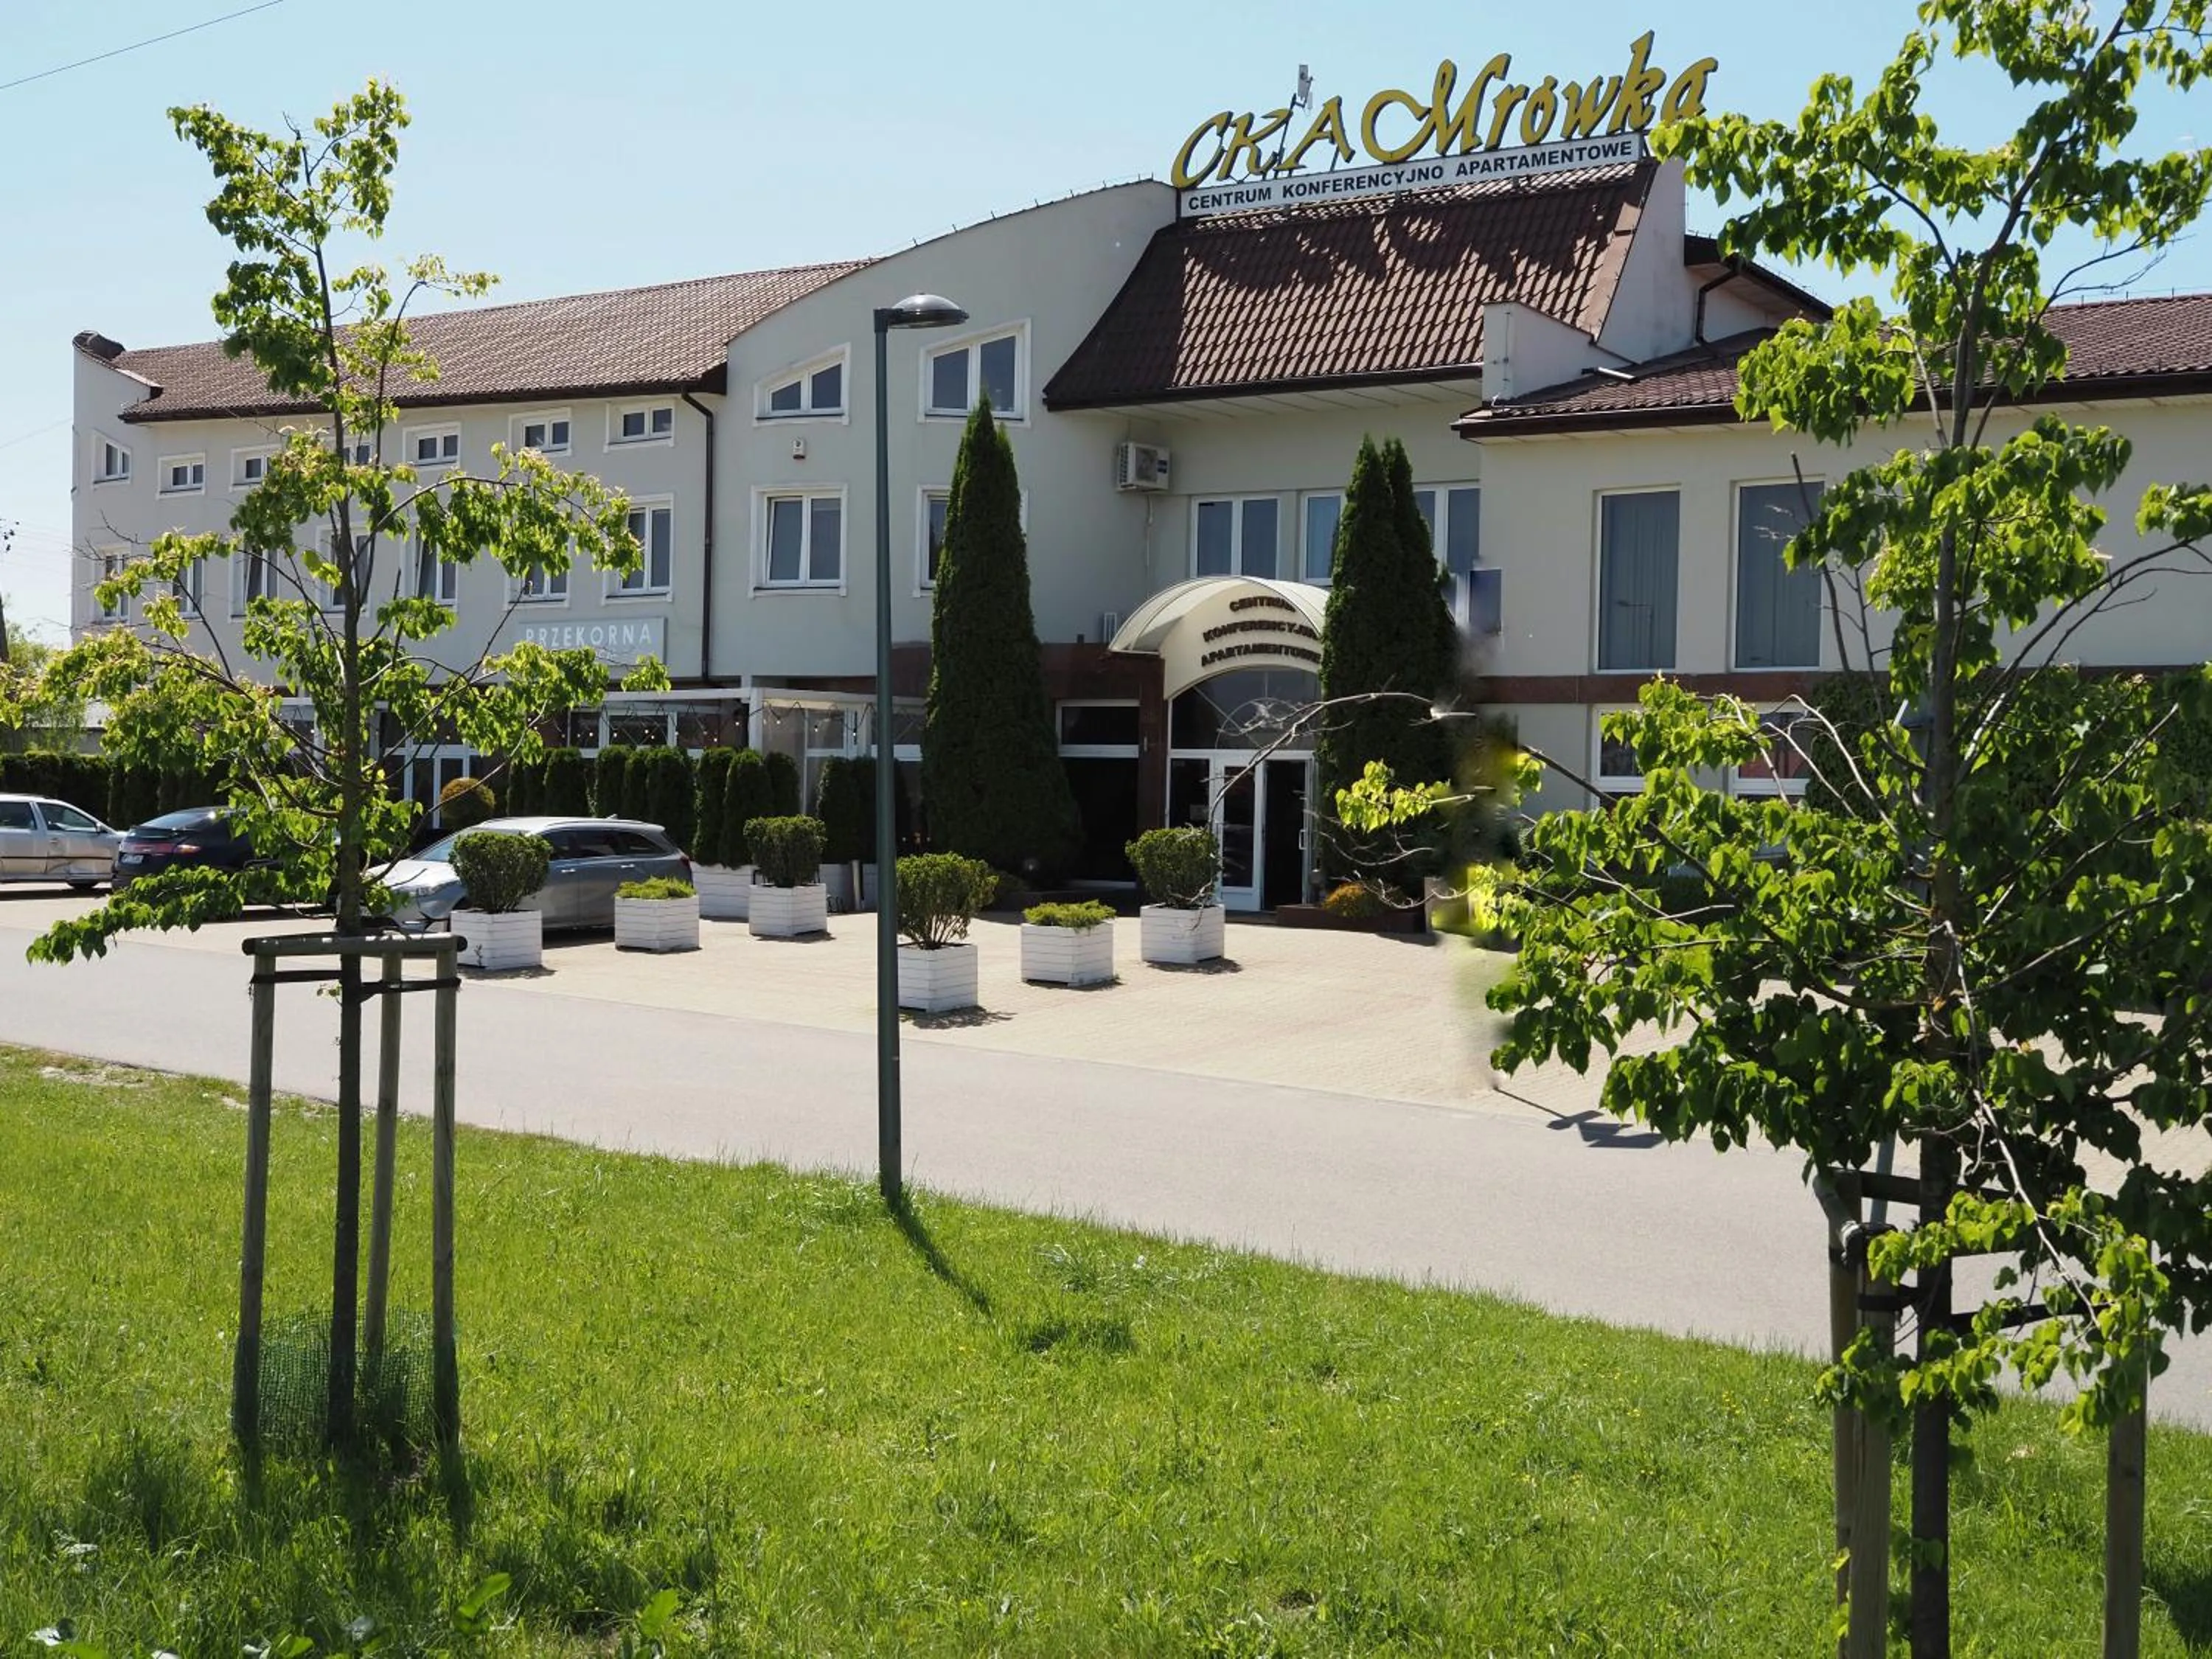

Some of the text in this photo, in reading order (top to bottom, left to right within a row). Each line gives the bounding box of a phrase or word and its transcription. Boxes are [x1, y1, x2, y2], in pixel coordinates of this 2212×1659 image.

[1188, 140, 1632, 211] CENTRUM KONFERENCYJNO APARTAMENTOWE
[526, 623, 652, 647] PRZEKORNA
